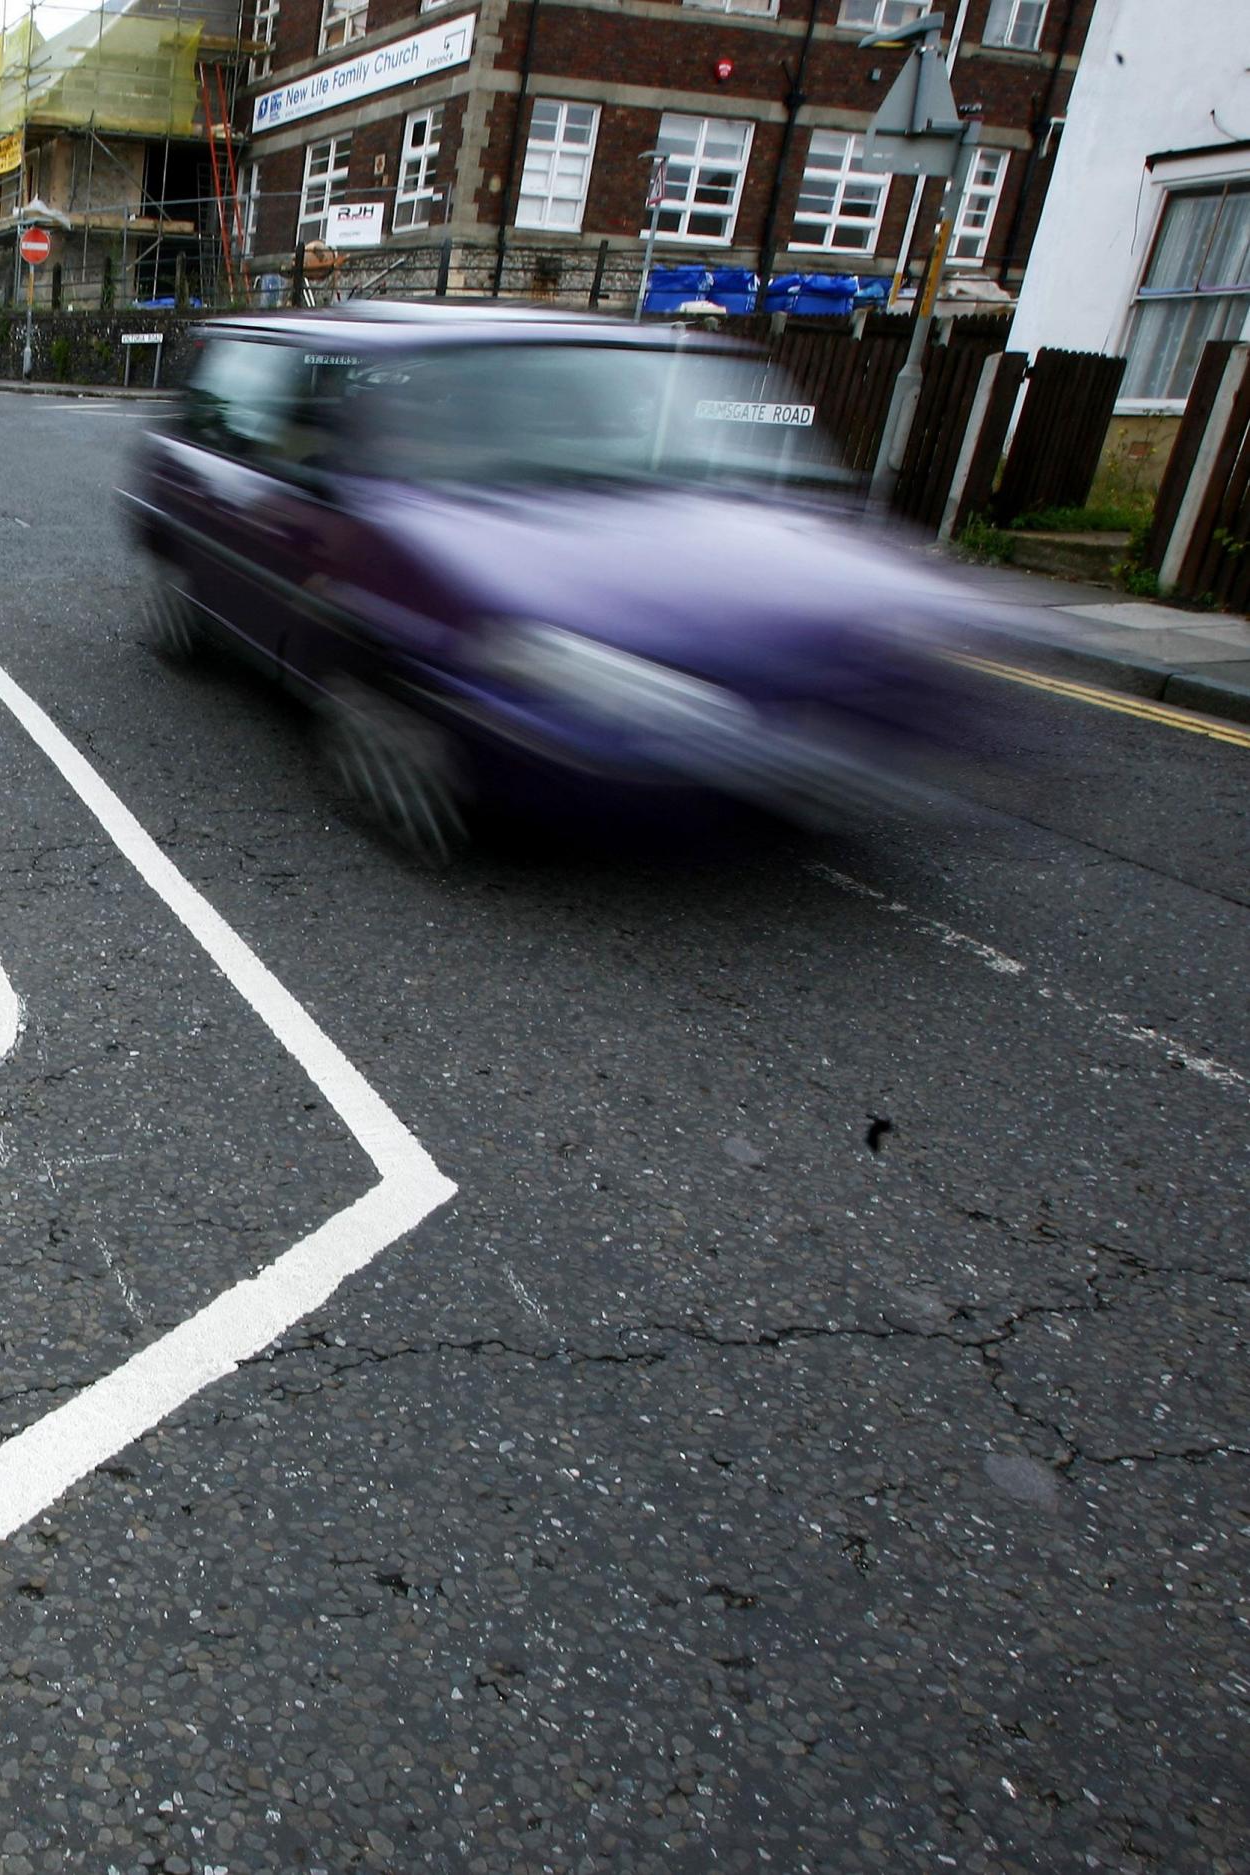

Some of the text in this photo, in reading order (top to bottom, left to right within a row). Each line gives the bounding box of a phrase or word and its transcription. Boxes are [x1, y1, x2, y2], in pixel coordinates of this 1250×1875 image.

[426, 52, 453, 68] Entrance
[285, 41, 419, 106] New Life Family Church
[338, 205, 375, 218] RJH
[773, 406, 810, 424] ROAD
